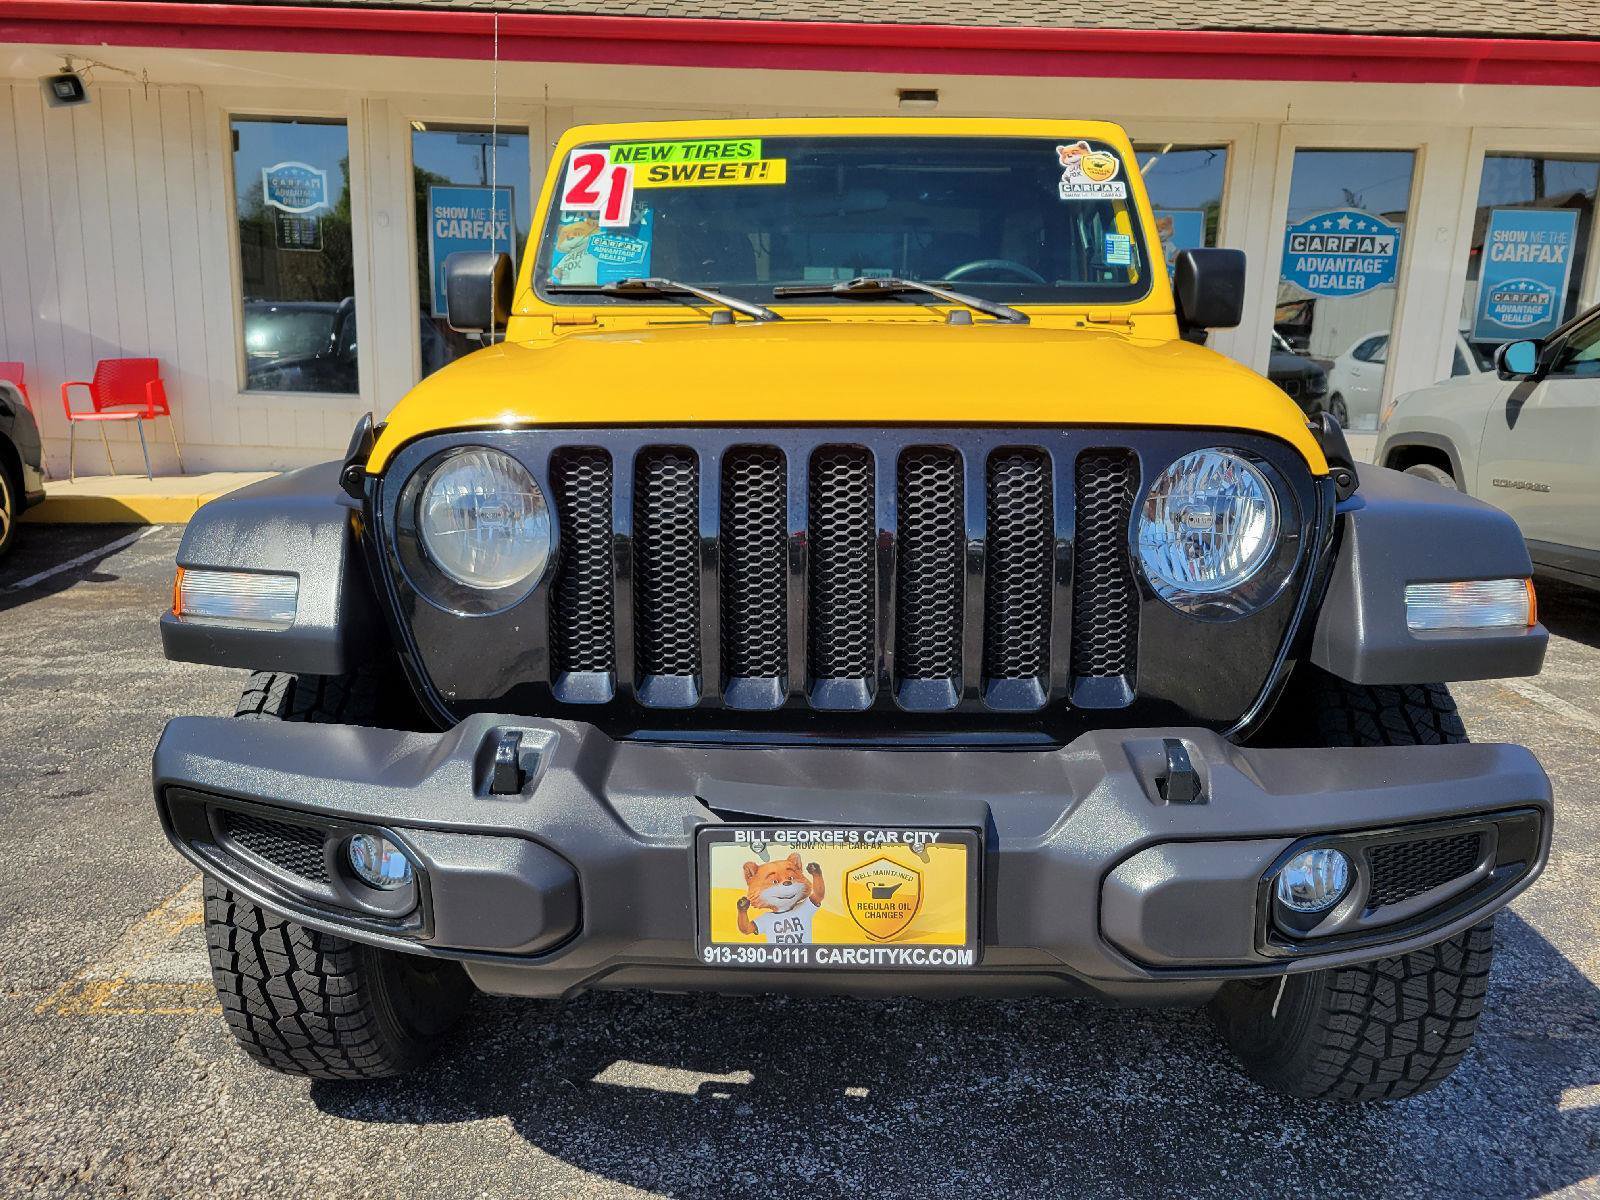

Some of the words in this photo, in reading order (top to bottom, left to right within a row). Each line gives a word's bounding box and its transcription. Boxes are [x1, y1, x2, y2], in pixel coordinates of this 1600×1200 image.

[614, 145, 672, 162] NEW
[682, 142, 753, 159] TIRES
[647, 162, 769, 182] SWEET!
[565, 153, 627, 220] 21
[1063, 184, 1121, 192] CARFAX
[435, 206, 468, 219] SHOW
[471, 208, 485, 219] ME
[489, 209, 507, 220] THE
[436, 219, 509, 240] CARFAX
[1493, 230, 1527, 242] SHOW
[1530, 231, 1546, 243] ME
[1550, 231, 1568, 244] THE
[1291, 235, 1390, 254] CARFAX
[1491, 242, 1566, 263] CARFAX
[1296, 257, 1382, 273] ADVANTAGE
[1308, 274, 1365, 289] DEALER
[1494, 294, 1548, 304] CARFAX
[1495, 304, 1543, 314] ADVANTAGE
[1502, 314, 1533, 322] DEALER
[735, 831, 770, 842] BILL
[774, 831, 859, 843] GEORGE'S
[863, 831, 898, 843] CAR
[902, 832, 940, 844] CITY
[857, 902, 895, 911] REGULAR
[898, 903, 911, 911] OIL
[864, 911, 904, 919] CHANGES
[774, 917, 804, 934] CAR
[775, 933, 804, 945] FOX
[703, 946, 808, 964] 913-390-0111
[815, 948, 973, 966] CARCITYKC.COM
